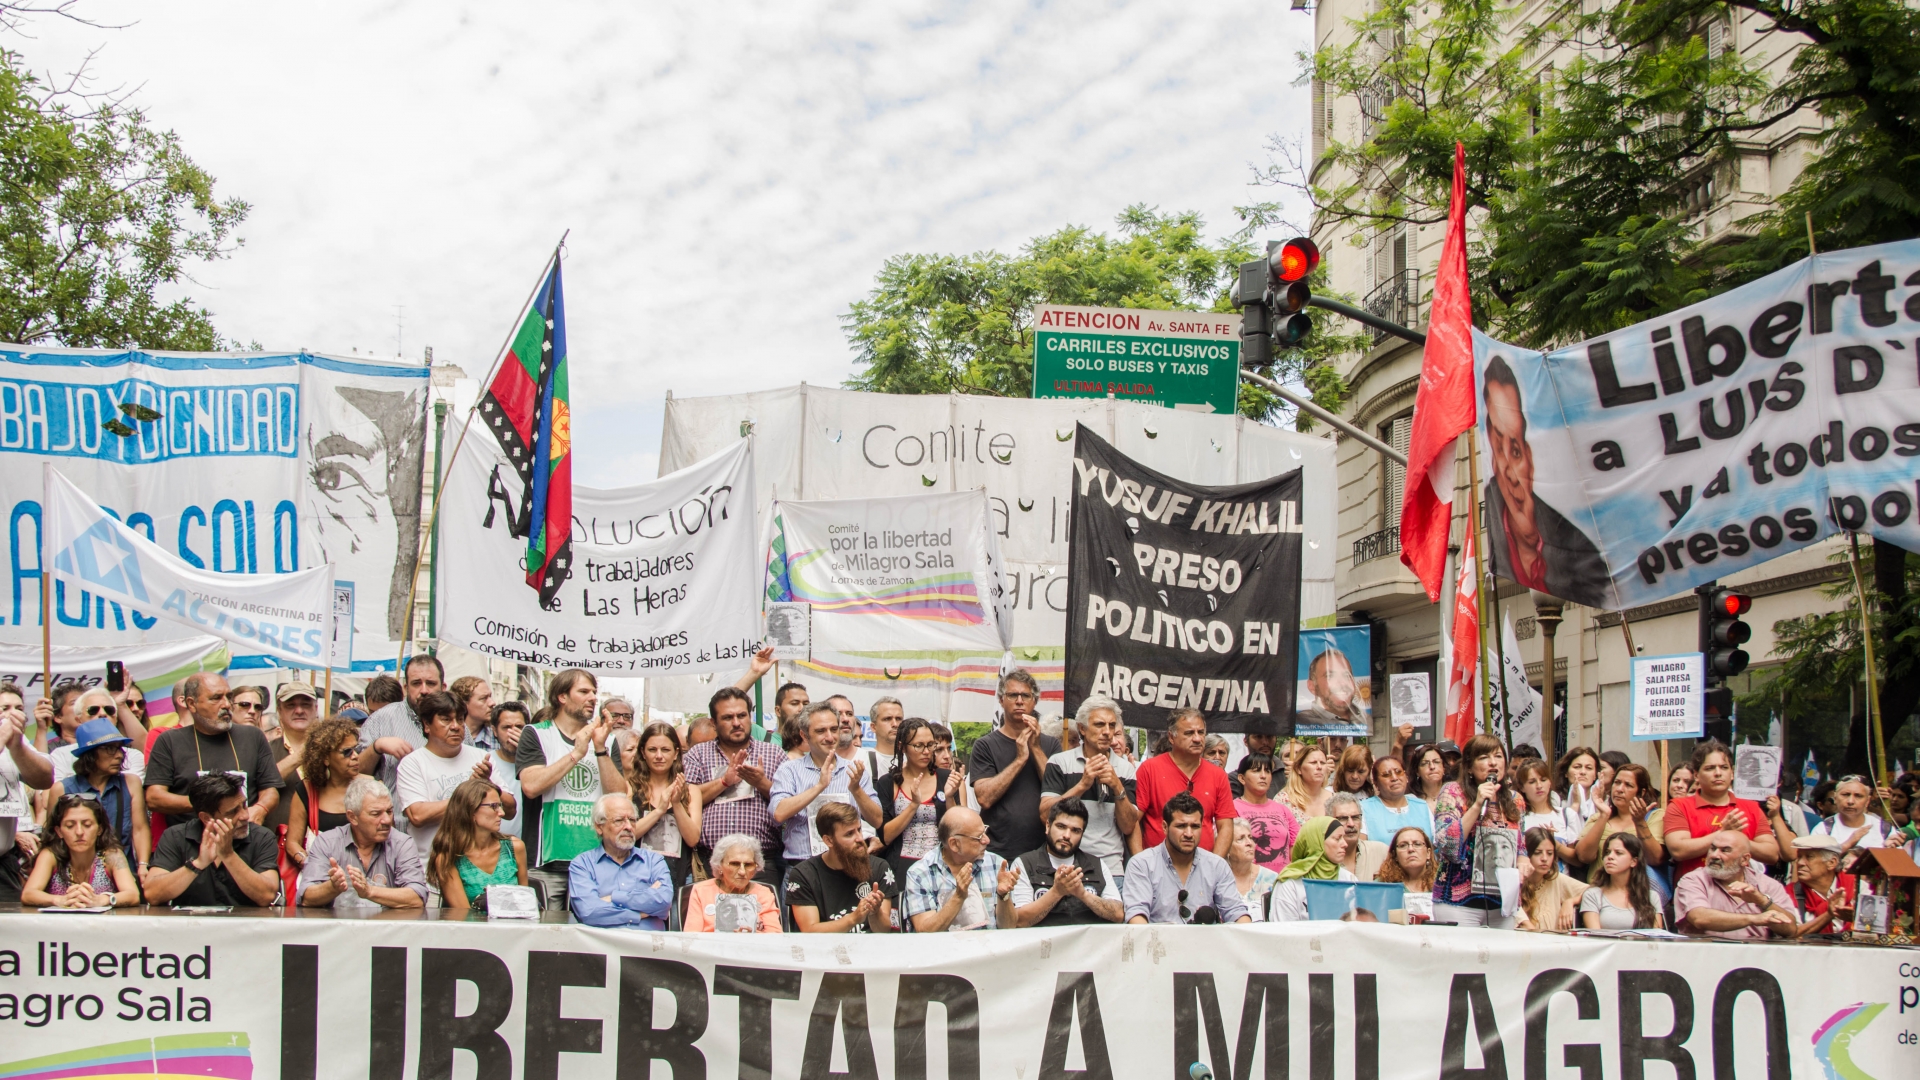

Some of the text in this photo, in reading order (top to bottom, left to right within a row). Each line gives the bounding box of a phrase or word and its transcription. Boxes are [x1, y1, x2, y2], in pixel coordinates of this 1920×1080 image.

[1040, 310, 1230, 335] ATENCION Av. SANTA FE
[1046, 338, 1230, 360] CARRILES EXCLUSIVOS
[1066, 358, 1209, 376] SOLO BUSES Y TAXIS
[1054, 380, 1155, 396] ULTIMA SALIDA
[107, 382, 130, 460] Y
[135, 382, 297, 460] DIGNIDAD
[1591, 439, 1625, 472] a
[1658, 361, 1806, 456] LUIS
[862, 419, 1016, 469] Comite
[1748, 421, 1920, 486] todos
[1073, 458, 1303, 535] YUSUF KHALIL
[828, 523, 859, 534] Comité
[830, 527, 952, 554] por la libertad
[1637, 506, 1818, 585] presos
[585, 552, 694, 583] trabajadores
[831, 550, 954, 574] de Milagro Sala
[1133, 543, 1242, 594] PRESO
[831, 576, 915, 586] Lomas de Zamora
[240, 602, 305, 621] ARGENTINA
[308, 612, 323, 623] DE
[584, 588, 620, 616] Las
[634, 583, 687, 616] Heras
[161, 588, 322, 658] ACTORES
[474, 616, 688, 654] Comisión de trabajadores
[1086, 594, 1280, 656] POLITICO EN
[641, 652, 691, 670] amigos
[697, 649, 711, 663] de
[715, 643, 738, 660] Las
[1651, 662, 1686, 673] MILAGRO
[1090, 661, 1269, 714] ARGENTINA
[1645, 674, 1691, 684] SALA PRESA
[1645, 685, 1691, 695] POLITICA DE
[1649, 709, 1685, 718] MORALES
[1650, 698, 1686, 707] GERARDO
[38, 941, 211, 980] libertad
[116, 987, 211, 1022] Sala
[1038, 971, 1113, 1080] A
[1897, 1029, 1918, 1045] de
